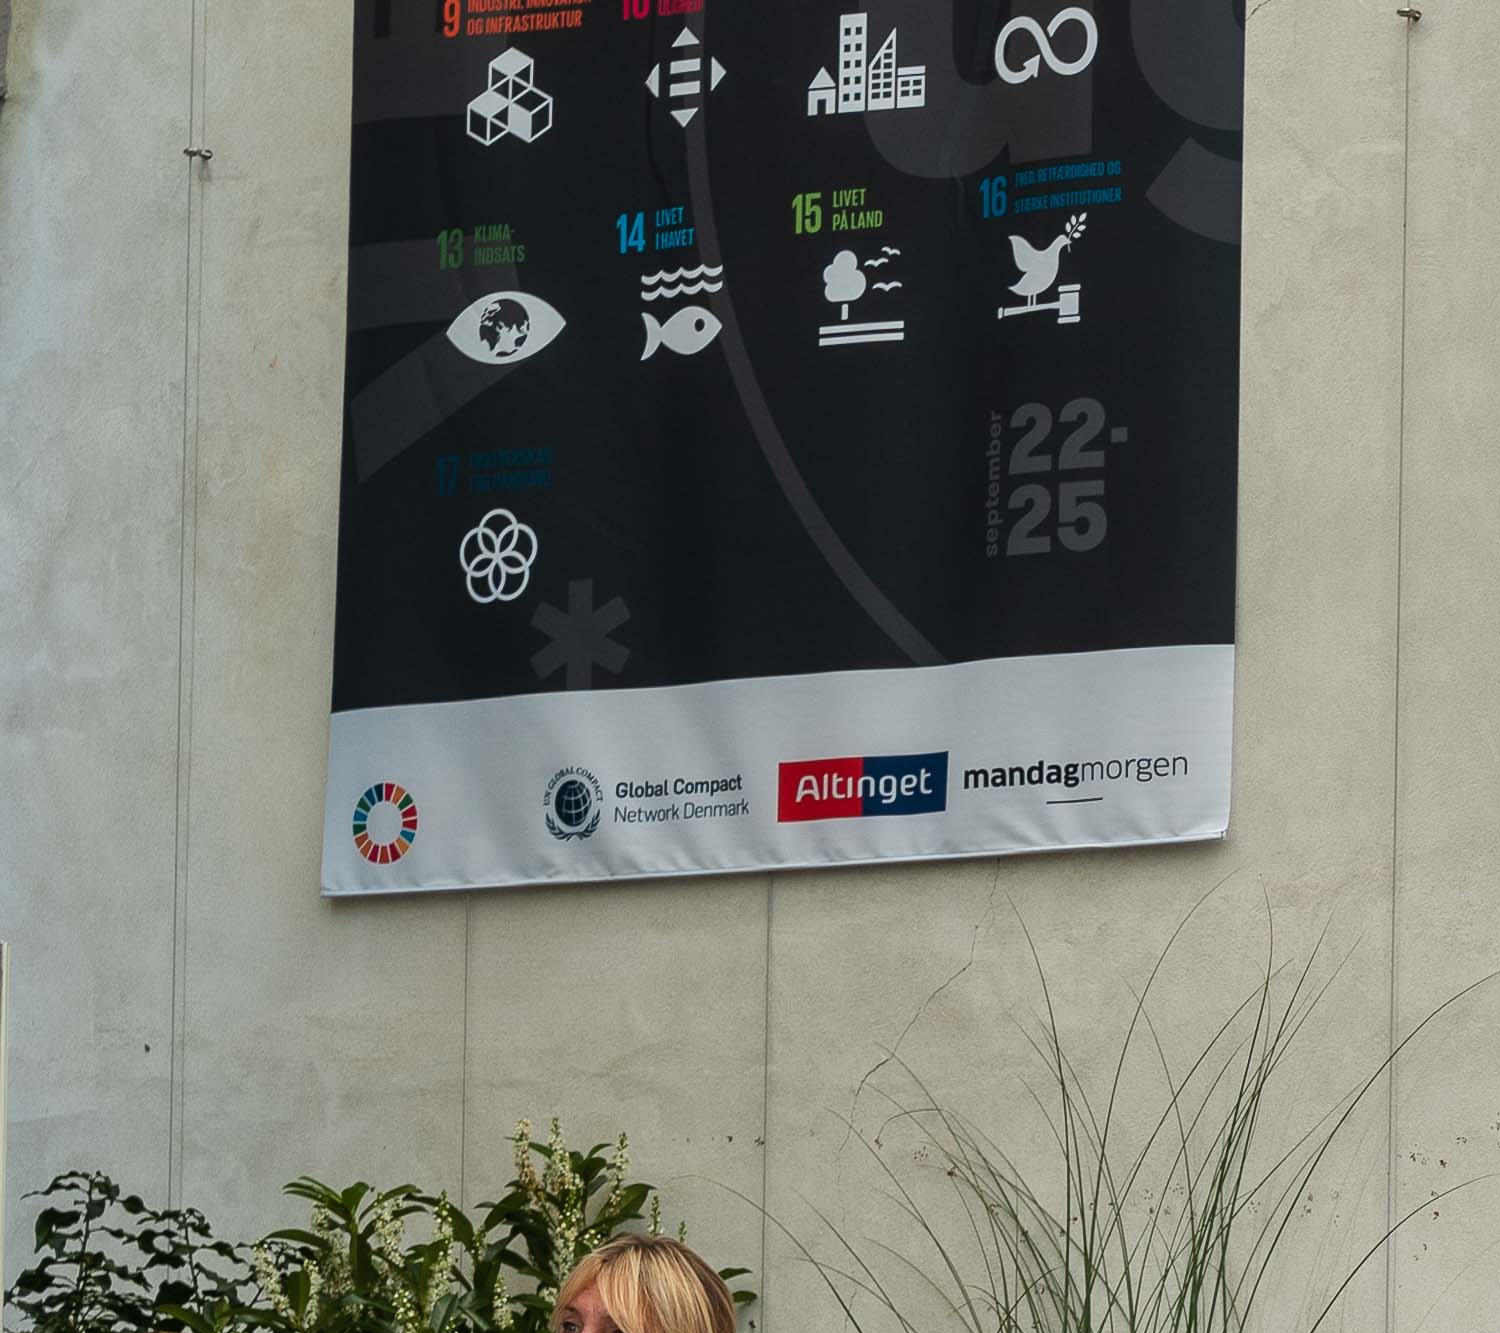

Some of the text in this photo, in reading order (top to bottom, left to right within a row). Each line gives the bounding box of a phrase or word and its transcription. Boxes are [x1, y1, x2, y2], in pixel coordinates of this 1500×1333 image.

[443, 0, 461, 38] 9
[467, 11, 583, 35] OG INFRASTRUKTUR
[792, 191, 822, 234] 15
[833, 188, 867, 208] LIVET
[979, 175, 1007, 219] 16
[655, 206, 685, 227] LIVET
[832, 210, 883, 232] PÅ LAND
[473, 223, 515, 242] KLIMA-
[616, 211, 646, 254] 14
[661, 228, 695, 248] HAVET
[437, 228, 464, 270] 13
[473, 244, 525, 266] INDSATS
[985, 409, 1003, 558] september
[1006, 479, 1108, 558] 25
[615, 774, 743, 799] Global Compact
[795, 766, 932, 805] Altinget
[963, 753, 1189, 791] mandagmorgen
[614, 798, 750, 823] Network Denmark
